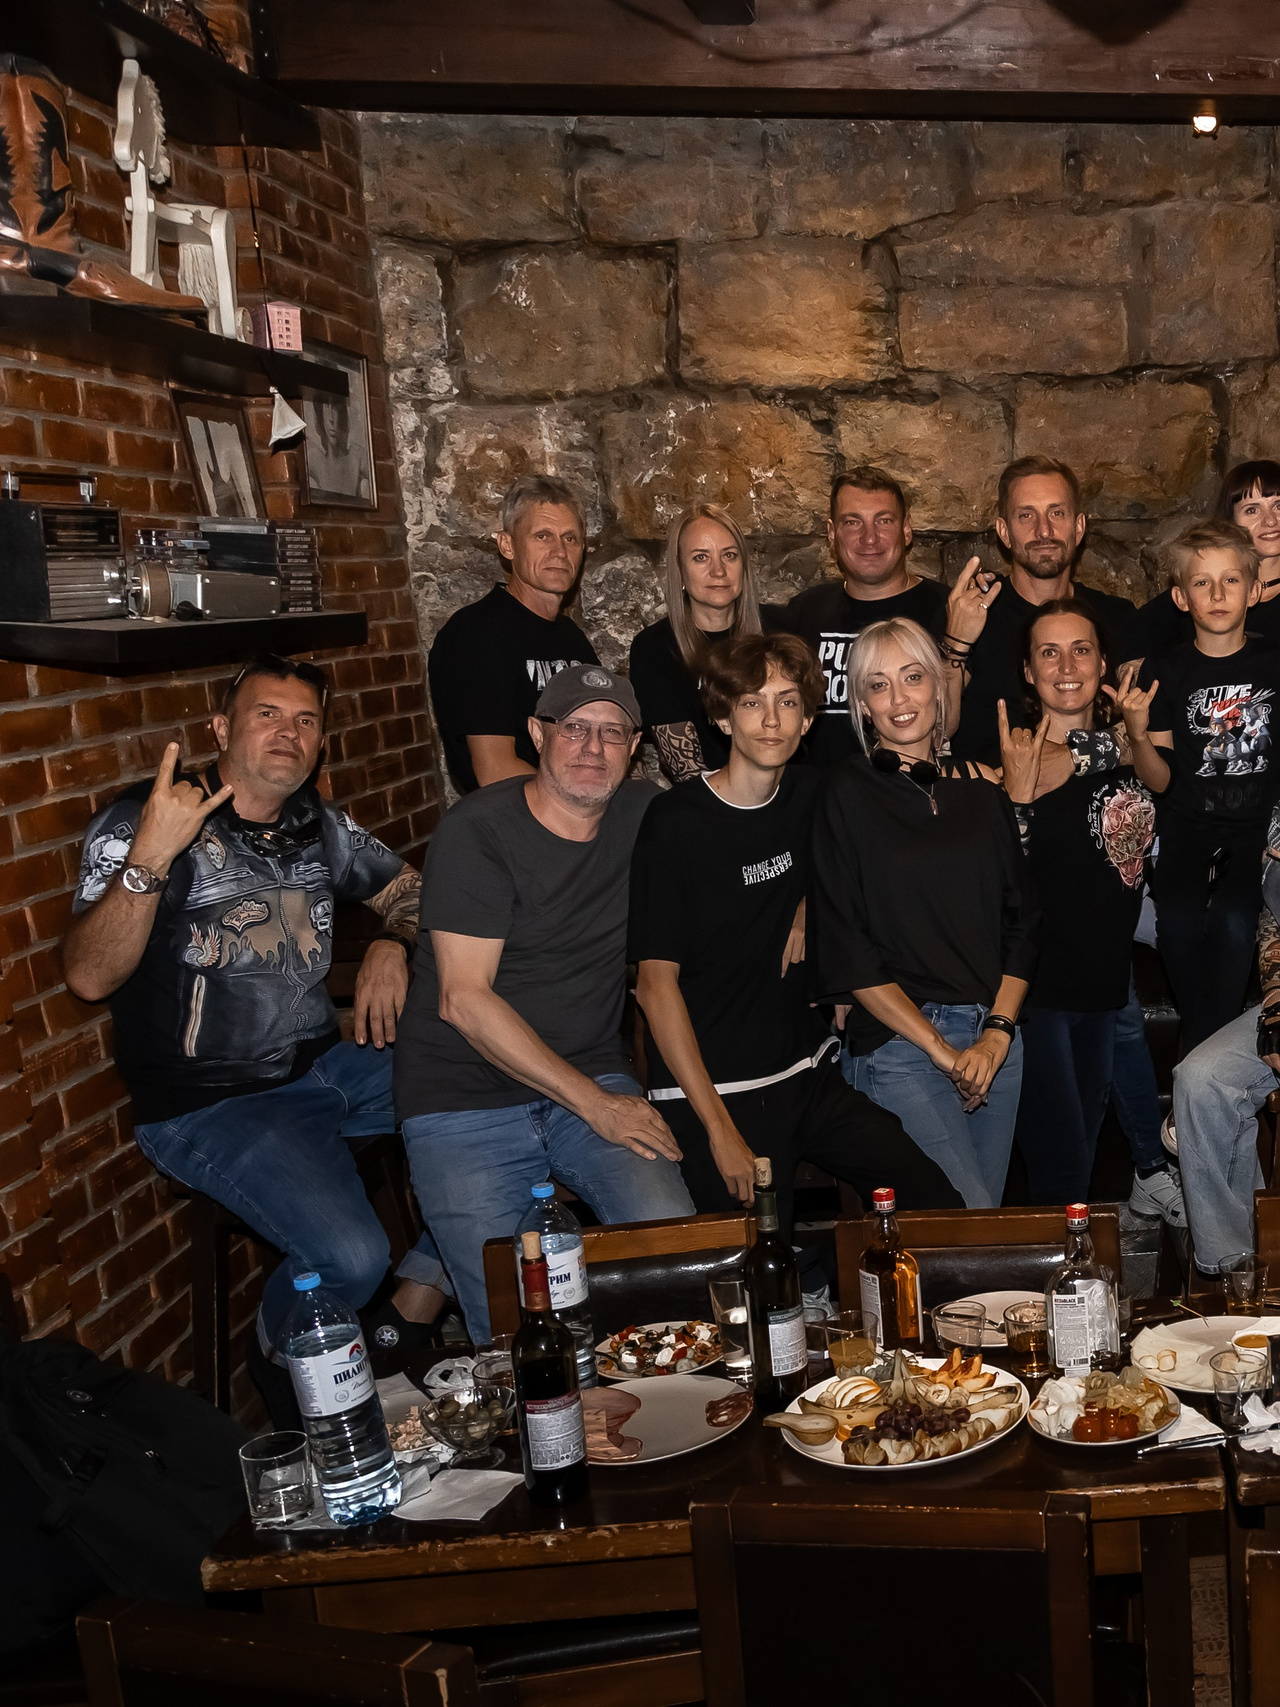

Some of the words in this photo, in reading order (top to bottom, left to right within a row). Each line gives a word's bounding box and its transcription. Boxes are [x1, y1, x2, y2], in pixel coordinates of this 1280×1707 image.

[742, 860, 769, 875] CHANGE
[771, 851, 791, 866] YOUR
[743, 861, 793, 885] PERSPECTIVE
